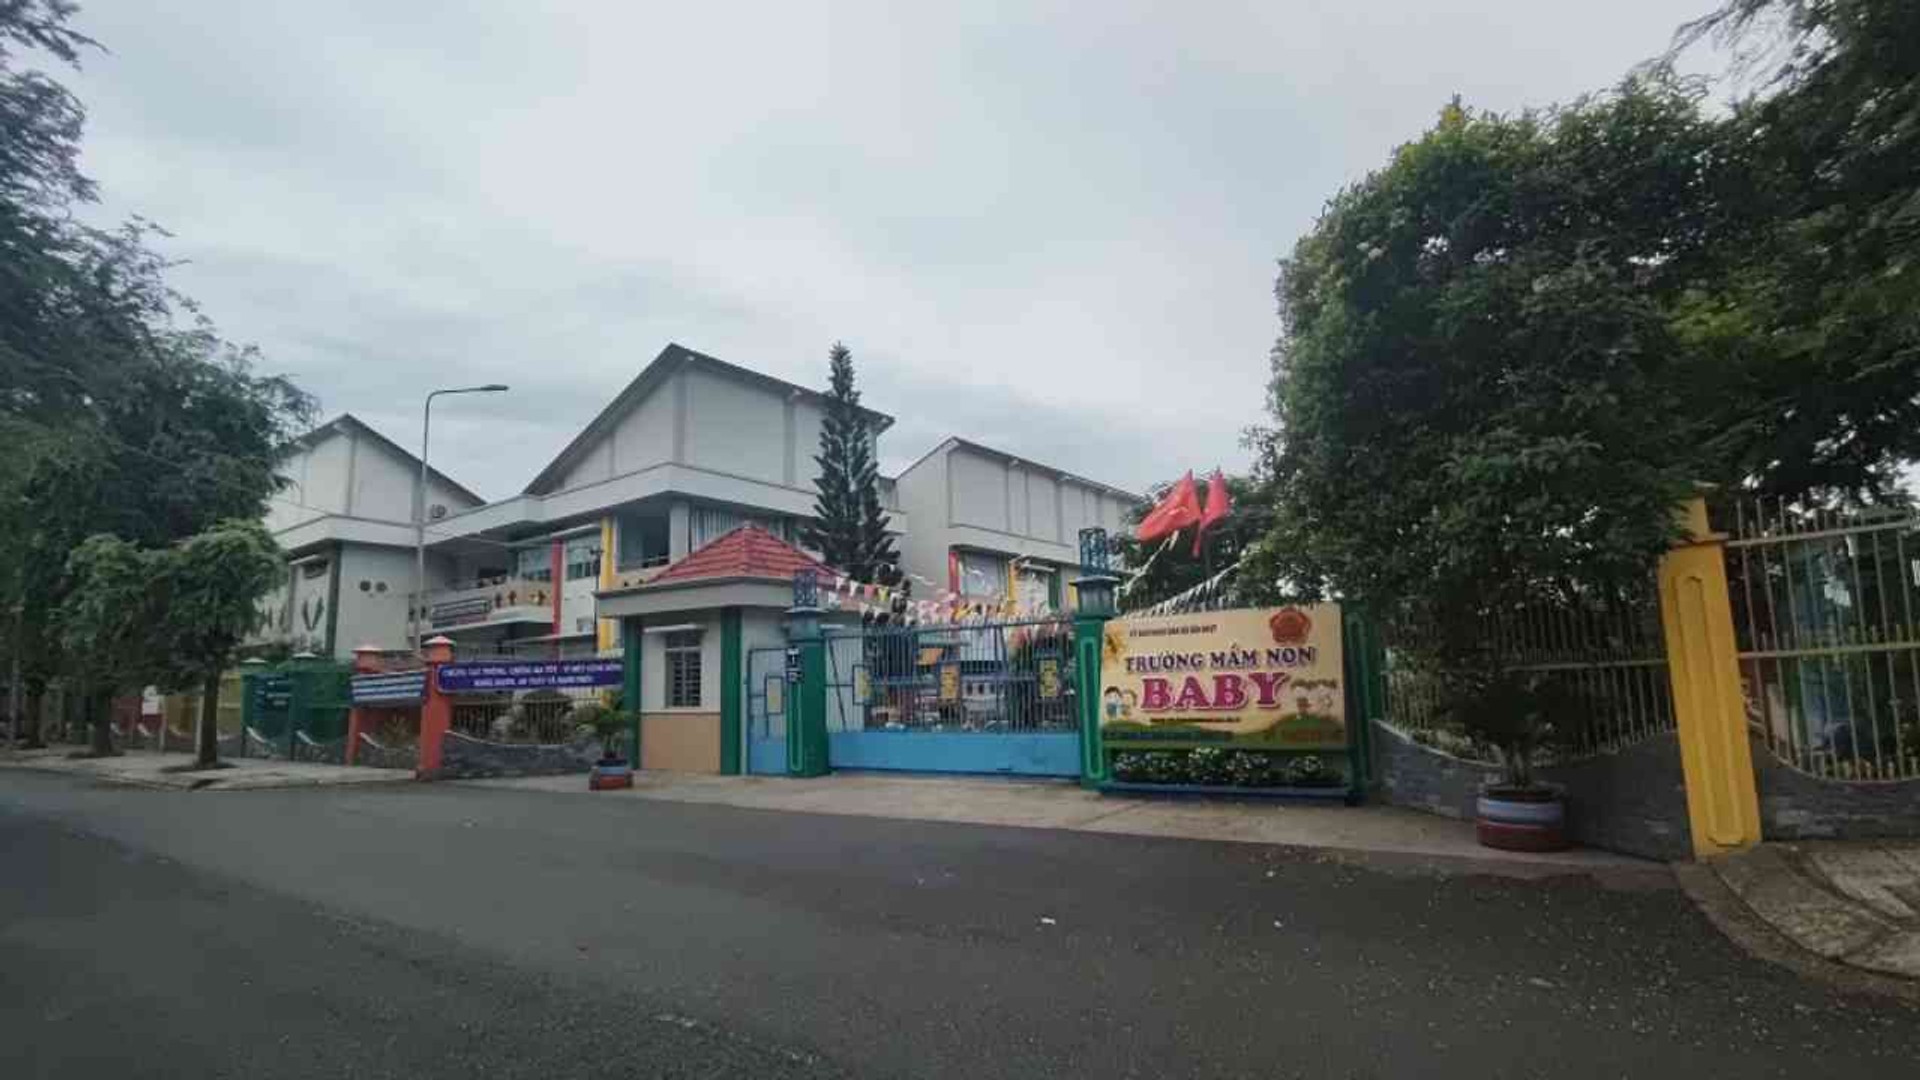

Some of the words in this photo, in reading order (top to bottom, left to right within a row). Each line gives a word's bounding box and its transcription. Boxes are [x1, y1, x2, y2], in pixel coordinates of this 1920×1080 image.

[1124, 650, 1203, 672] TRƯỜNG
[1266, 646, 1315, 667] NON
[1140, 672, 1290, 710] BABY
